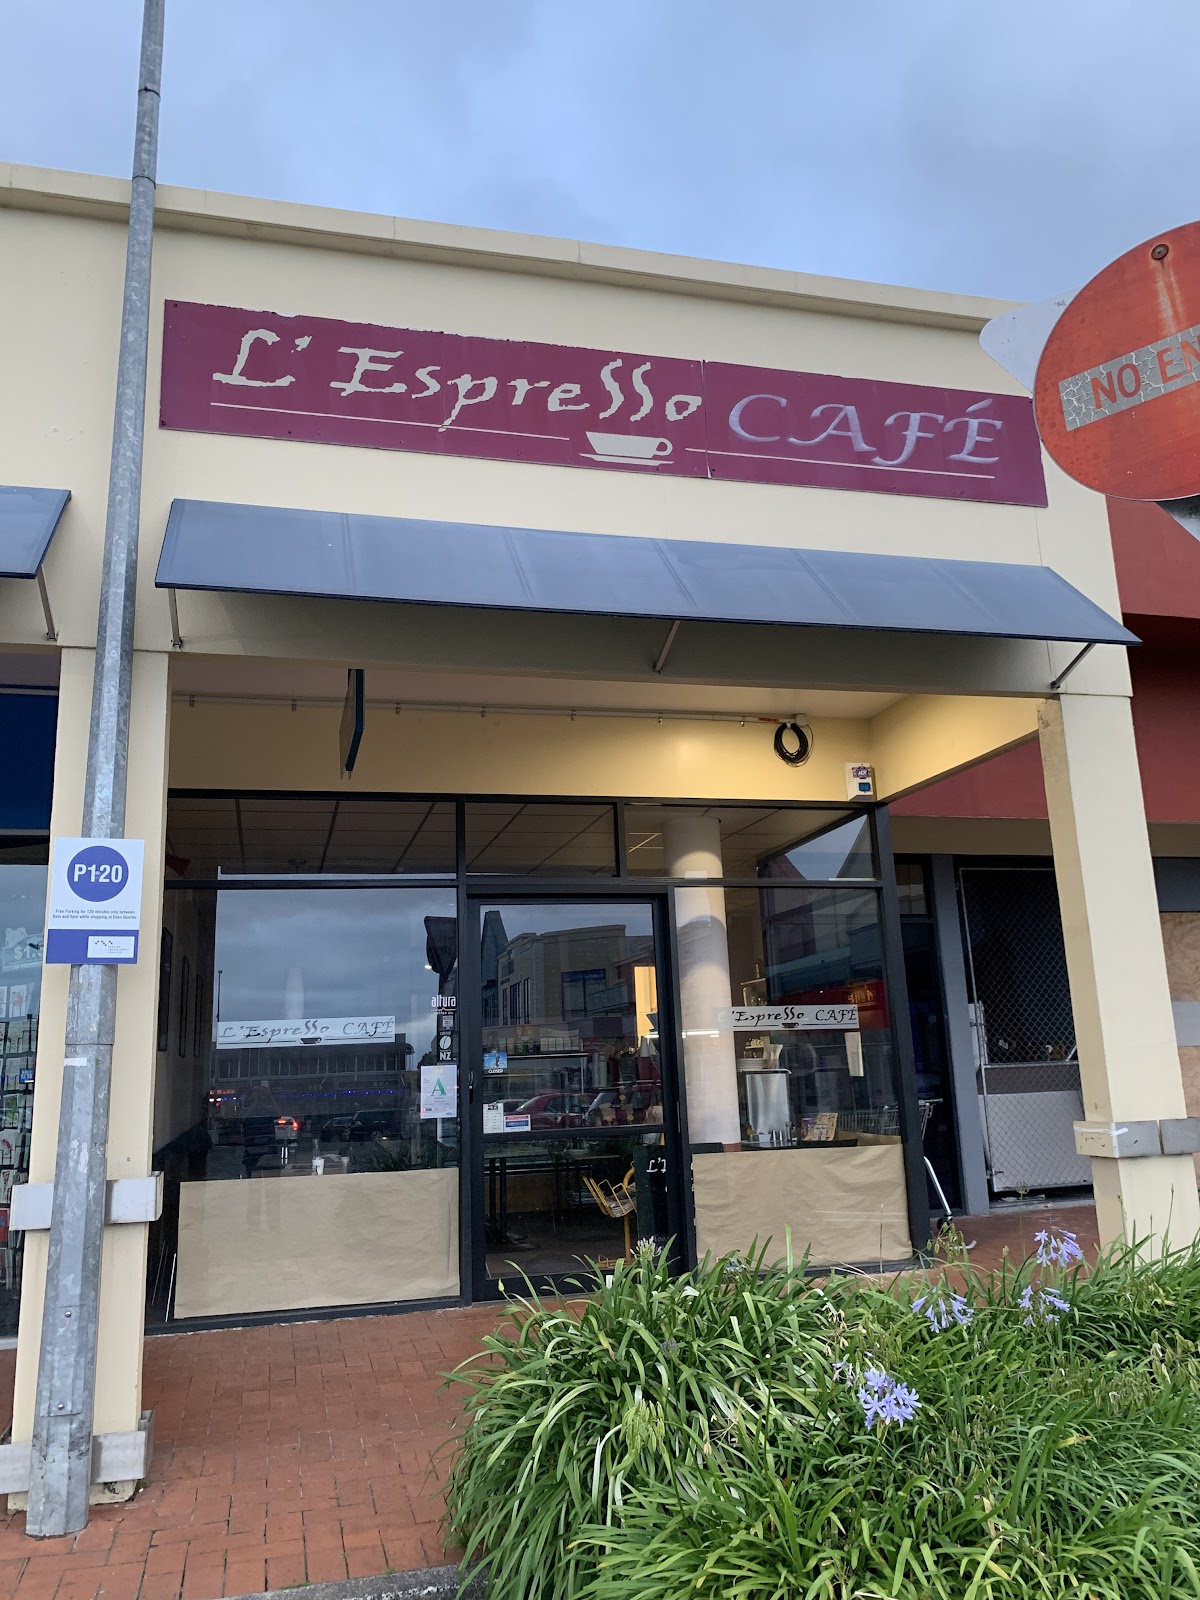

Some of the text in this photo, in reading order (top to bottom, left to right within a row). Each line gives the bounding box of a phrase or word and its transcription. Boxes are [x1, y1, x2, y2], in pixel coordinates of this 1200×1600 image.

[1090, 362, 1142, 411] NO
[728, 394, 1003, 466] CAFÉ
[73, 864, 123, 883] P120
[431, 994, 456, 1007] altura
[815, 1006, 858, 1023] CAFÉ
[342, 1017, 395, 1037] CAFÉ
[439, 1052, 451, 1060] NZ
[430, 1077, 447, 1096] A
